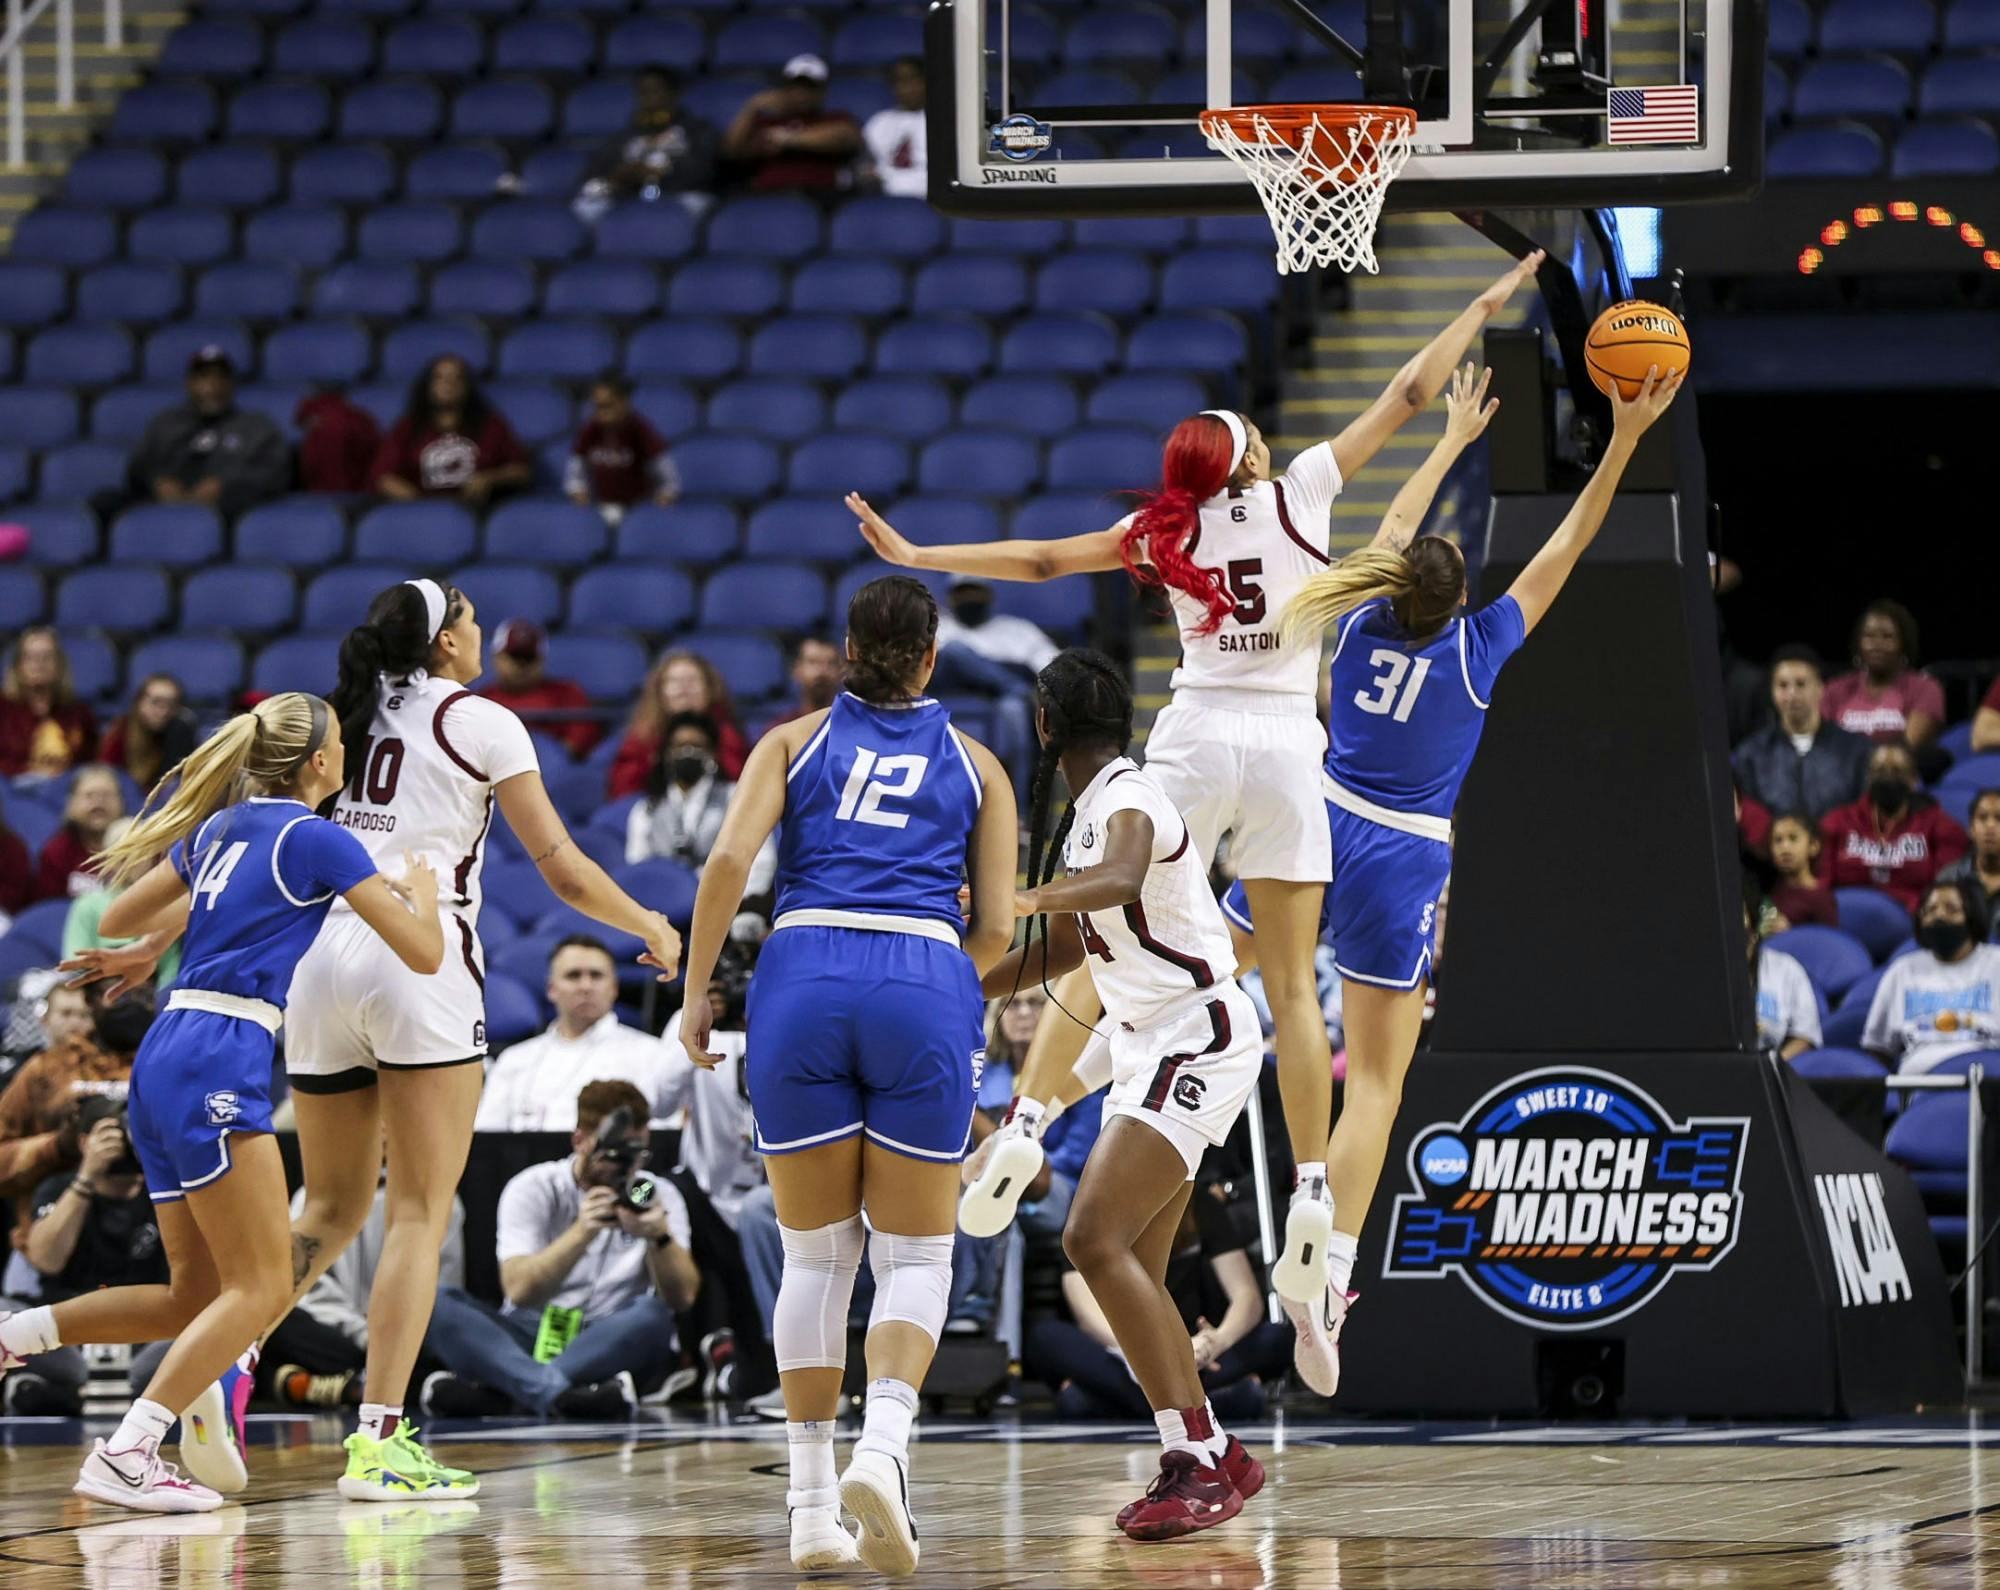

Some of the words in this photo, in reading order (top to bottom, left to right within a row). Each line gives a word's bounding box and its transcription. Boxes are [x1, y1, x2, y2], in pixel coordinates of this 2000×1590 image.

[981, 167, 1057, 185] SPALDING
[1610, 314, 1679, 338] Wilson
[1228, 558, 1267, 625] 5
[1219, 632, 1280, 652] SAXTON
[1353, 648, 1433, 723] 31
[834, 744, 929, 829] 12
[333, 807, 396, 833] CARDOSO
[190, 840, 250, 911] 14
[1515, 1086, 1580, 1118] SWEET
[1469, 1138, 1650, 1191] MARCH
[1490, 1192, 1732, 1244] MADNESS
[1814, 1173, 1912, 1308] NCAA
[1527, 1283, 1584, 1310] ELITE
[1587, 1284, 1602, 1306] 8
